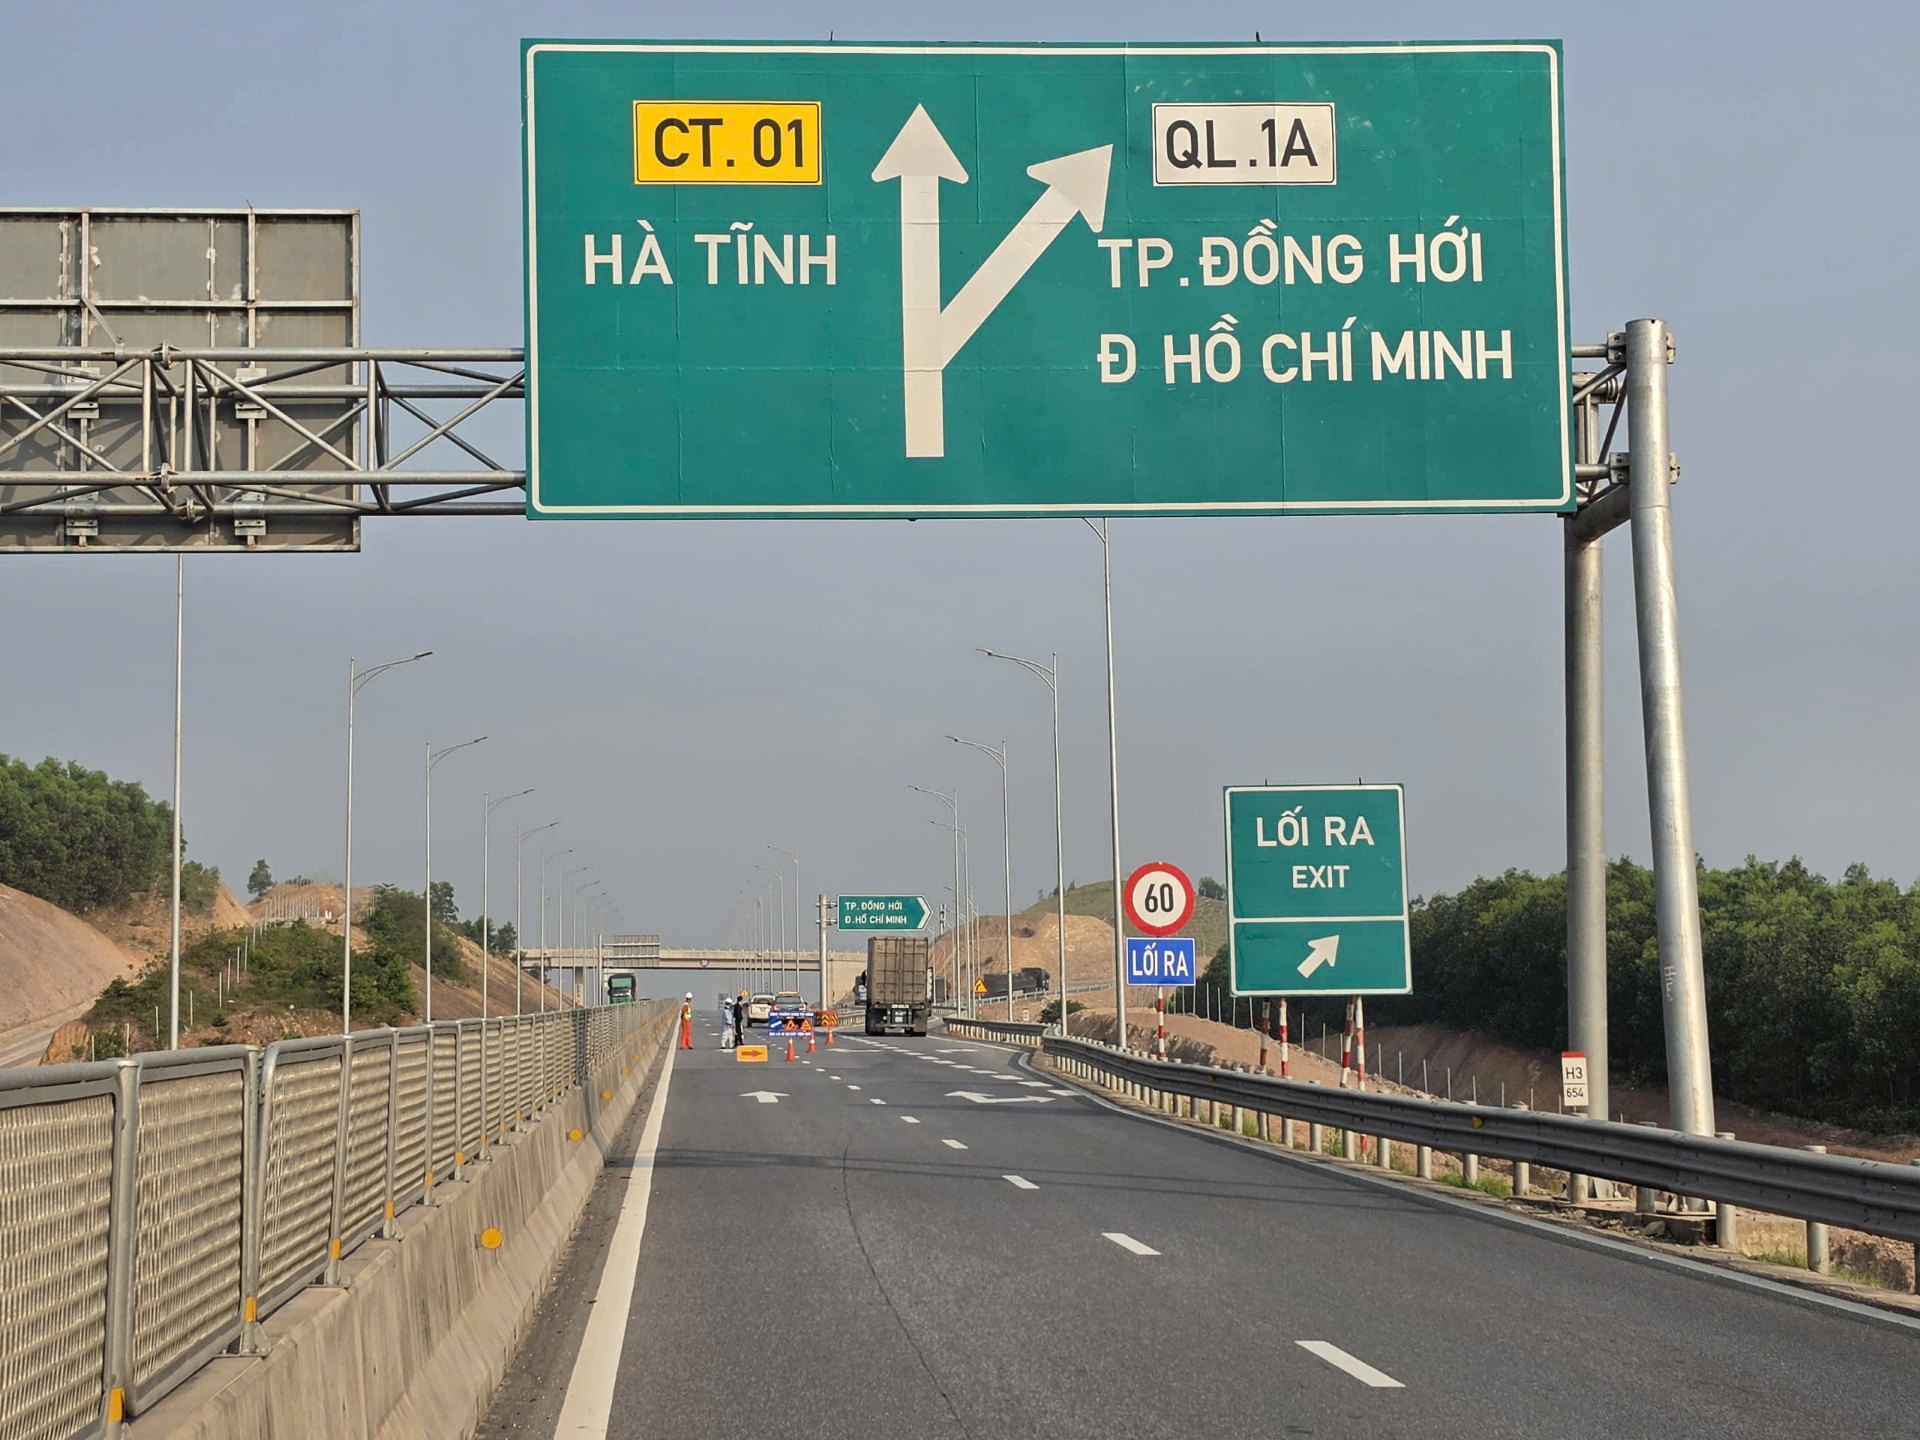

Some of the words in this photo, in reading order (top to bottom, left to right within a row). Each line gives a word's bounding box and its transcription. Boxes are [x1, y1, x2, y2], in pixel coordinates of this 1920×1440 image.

[584, 219, 673, 285] HÀ
[694, 221, 837, 285] TĨNH
[1390, 215, 1483, 283] HỚI
[1097, 333, 1136, 384] Đ
[1163, 313, 1241, 384] HỒ
[1262, 316, 1357, 384] CHÍ
[1371, 329, 1513, 381] MINH
[1256, 805, 1309, 847] LỐI
[1324, 816, 1375, 847] RA
[1292, 865, 1350, 889] EXIT
[1144, 883, 1174, 913] 60
[869, 914, 884, 924] CHÍ
[885, 915, 907, 924] MINH
[1132, 942, 1158, 977] LỐI
[1163, 950, 1189, 977] RA
[1565, 1067, 1583, 1079] H3
[1566, 1087, 1584, 1098] 654
